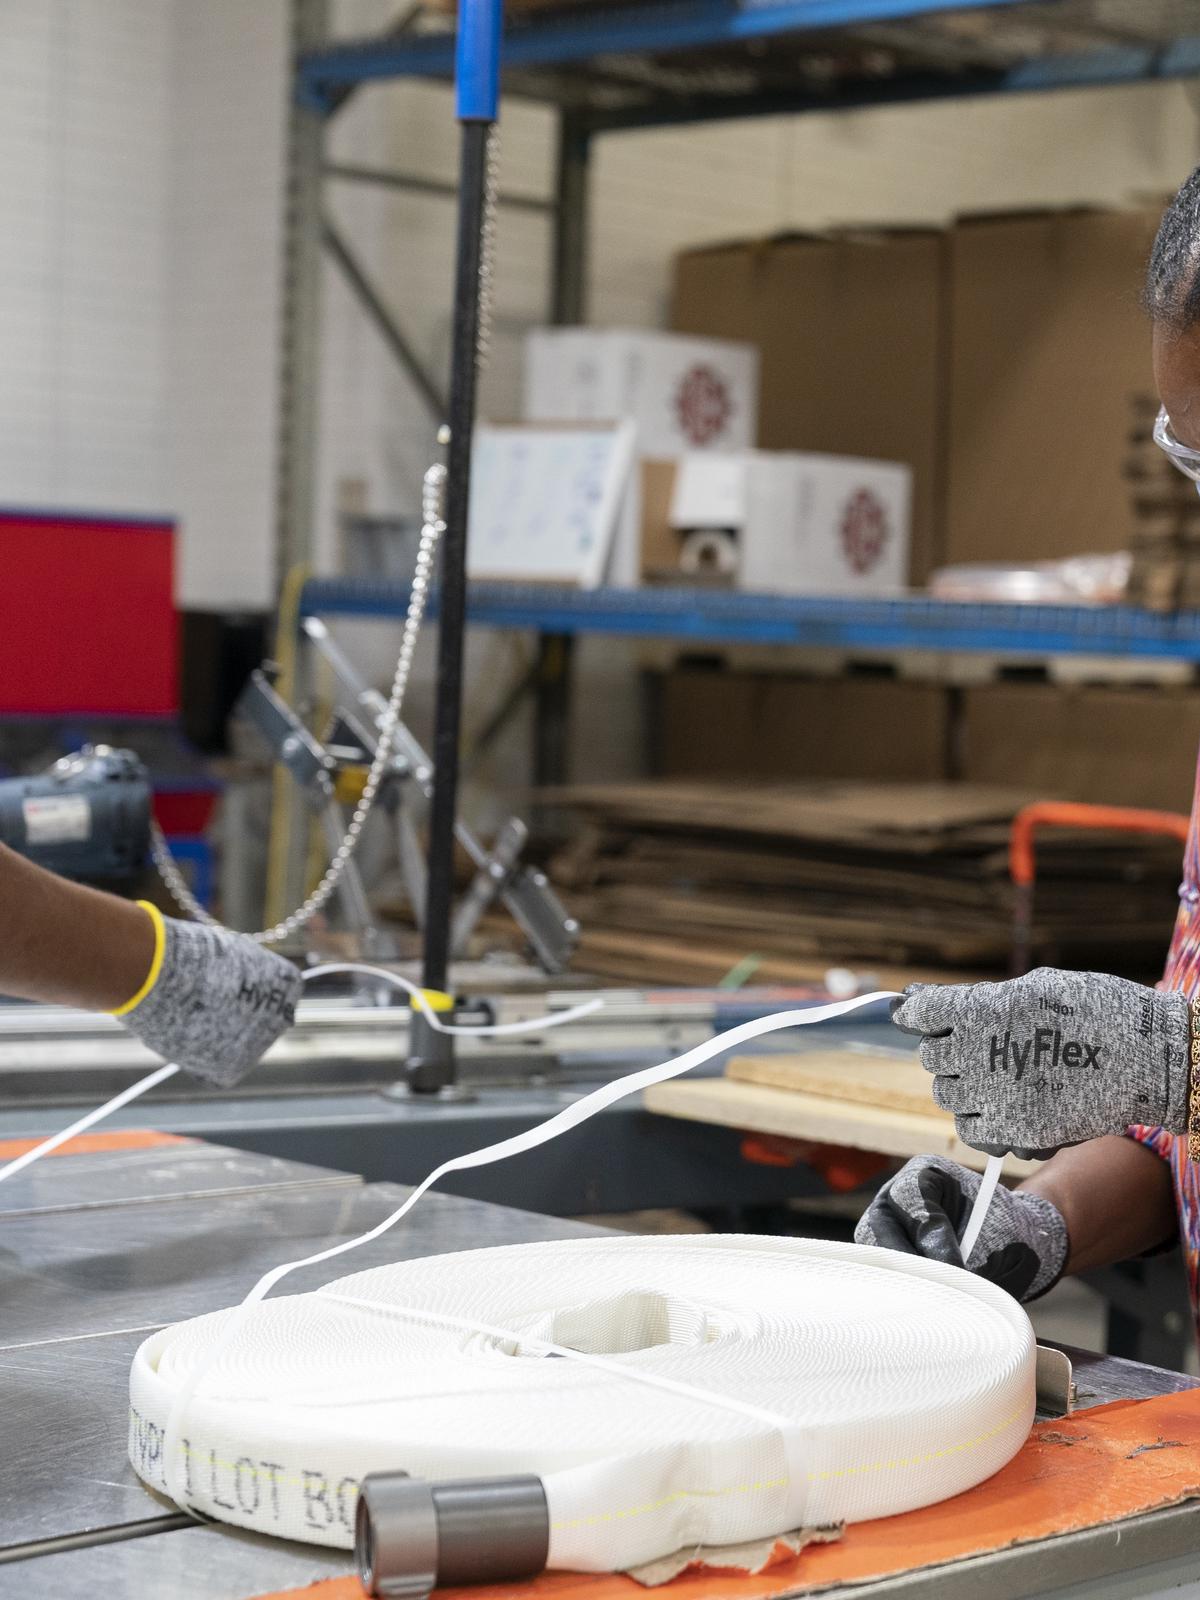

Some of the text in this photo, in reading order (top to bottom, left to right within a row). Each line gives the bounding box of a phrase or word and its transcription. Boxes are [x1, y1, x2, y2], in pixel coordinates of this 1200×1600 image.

[237, 979, 296, 1027] HyFle
[1038, 997, 1074, 1016] 11-801
[1138, 996, 1153, 1041] Ansell
[989, 1027, 1101, 1081] HyFlex
[209, 1449, 284, 1520] LOT
